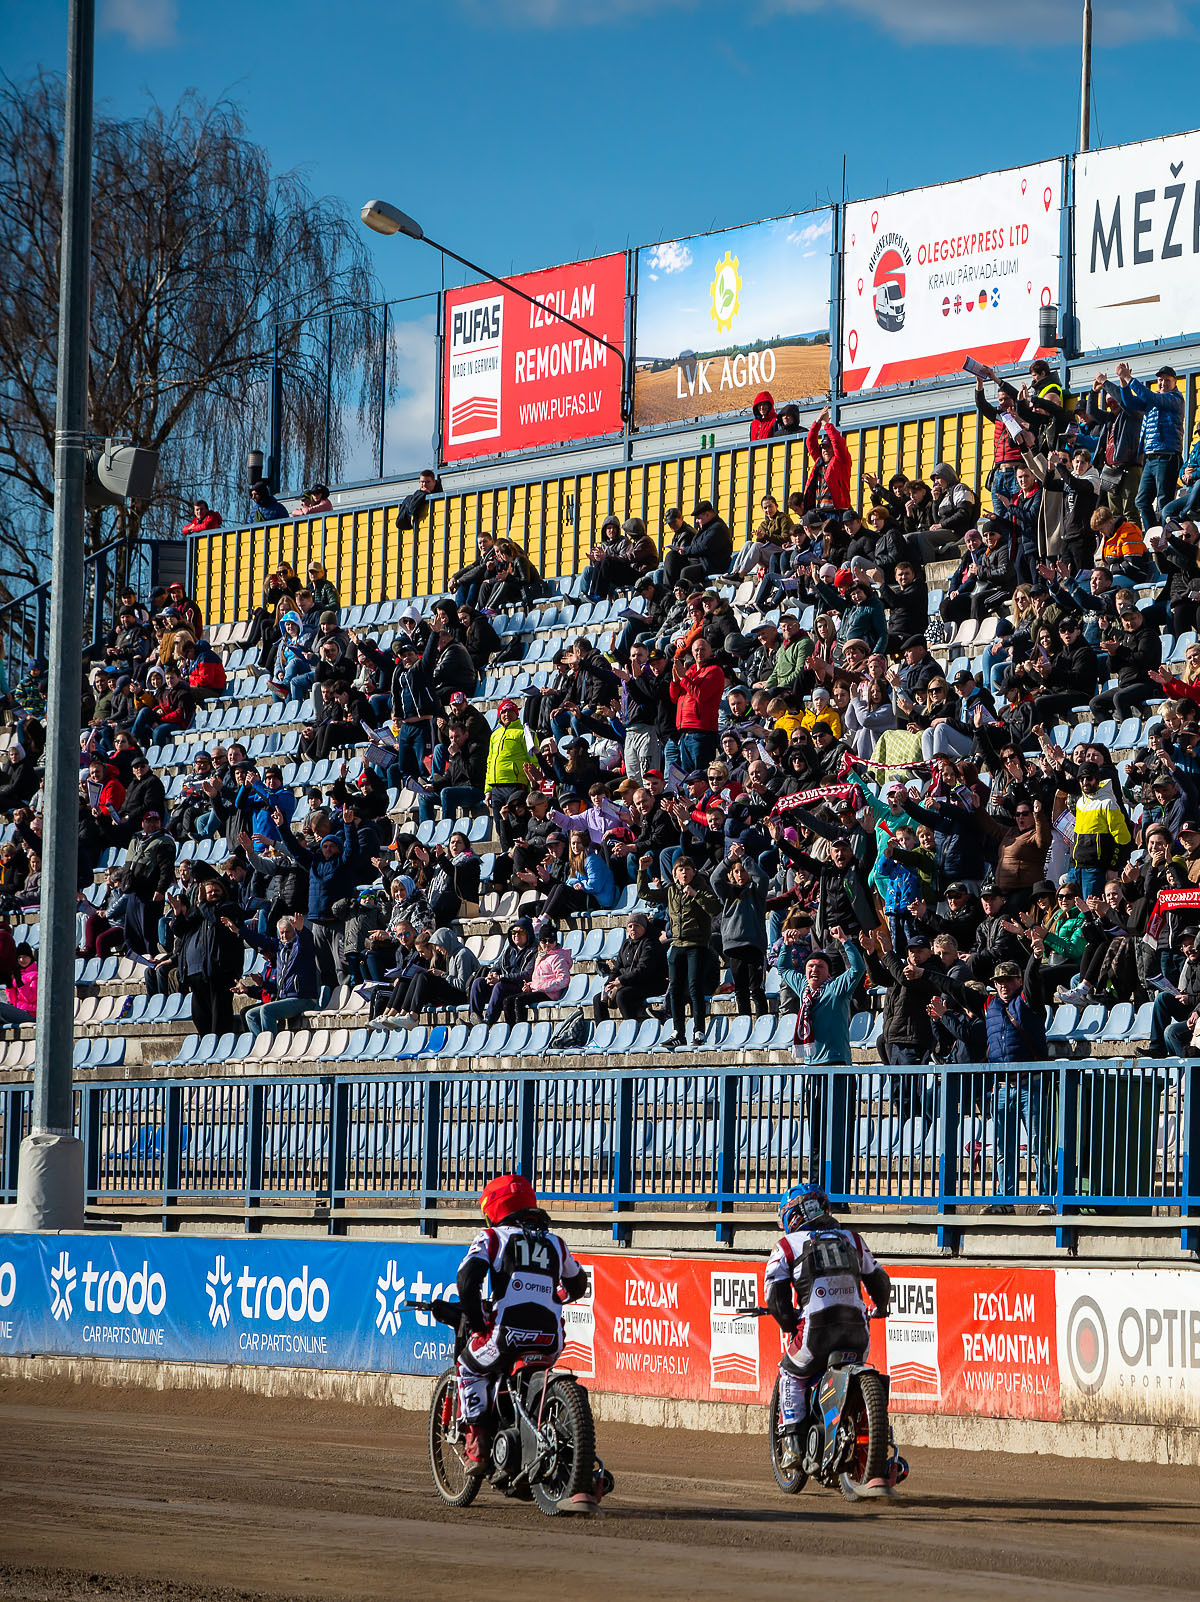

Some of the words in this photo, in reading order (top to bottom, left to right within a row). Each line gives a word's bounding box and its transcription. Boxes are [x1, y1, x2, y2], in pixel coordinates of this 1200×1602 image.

[918, 228, 1004, 265] OLEGSEXPRESS
[1009, 223, 1029, 247] LTD
[928, 269, 956, 291] KRAVU
[957, 258, 1019, 285] PĀRVADĀJUMI
[529, 283, 595, 328] IZCILAM
[453, 304, 500, 346] PUFAS
[452, 362, 466, 378] MADE
[467, 360, 473, 375] IN
[474, 356, 499, 374] GERMANY
[515, 334, 608, 384] REMONTAM
[677, 362, 712, 399] LVK
[720, 348, 776, 391] AGRO
[519, 390, 602, 425] WWW.PUFAS.LV
[516, 1240, 550, 1269] 14
[817, 1243, 843, 1268] 11
[81, 1260, 167, 1316] trodo
[236, 1265, 330, 1323] trodo
[525, 1282, 553, 1294] OPTIBET
[625, 1279, 679, 1309] IZCILAM
[713, 1278, 756, 1308] PUFAS
[889, 1284, 934, 1315] PUFAS
[565, 1311, 571, 1323] IN
[973, 1292, 1035, 1323] IZCILAM
[82, 1325, 101, 1342] CAR
[103, 1326, 130, 1344] PARTS
[132, 1327, 165, 1345] ONLINE
[239, 1332, 259, 1350] CAR
[261, 1334, 292, 1352] PARTS
[293, 1336, 328, 1354] ONLINE
[613, 1316, 690, 1347] REMONTAM
[713, 1321, 727, 1334] MADE
[727, 1323, 733, 1334] IN
[734, 1322, 756, 1335] GERMANY
[888, 1329, 902, 1342] MADE
[903, 1329, 910, 1342] IN
[911, 1330, 935, 1343] GERMANY
[414, 1341, 437, 1360] CAR
[616, 1351, 690, 1375] WWW.PUFAS.LV
[961, 1333, 1050, 1365] REMONTAM
[962, 1371, 1050, 1395] WWW.PUFAS.LV
[1119, 1374, 1186, 1390] SPORTA
